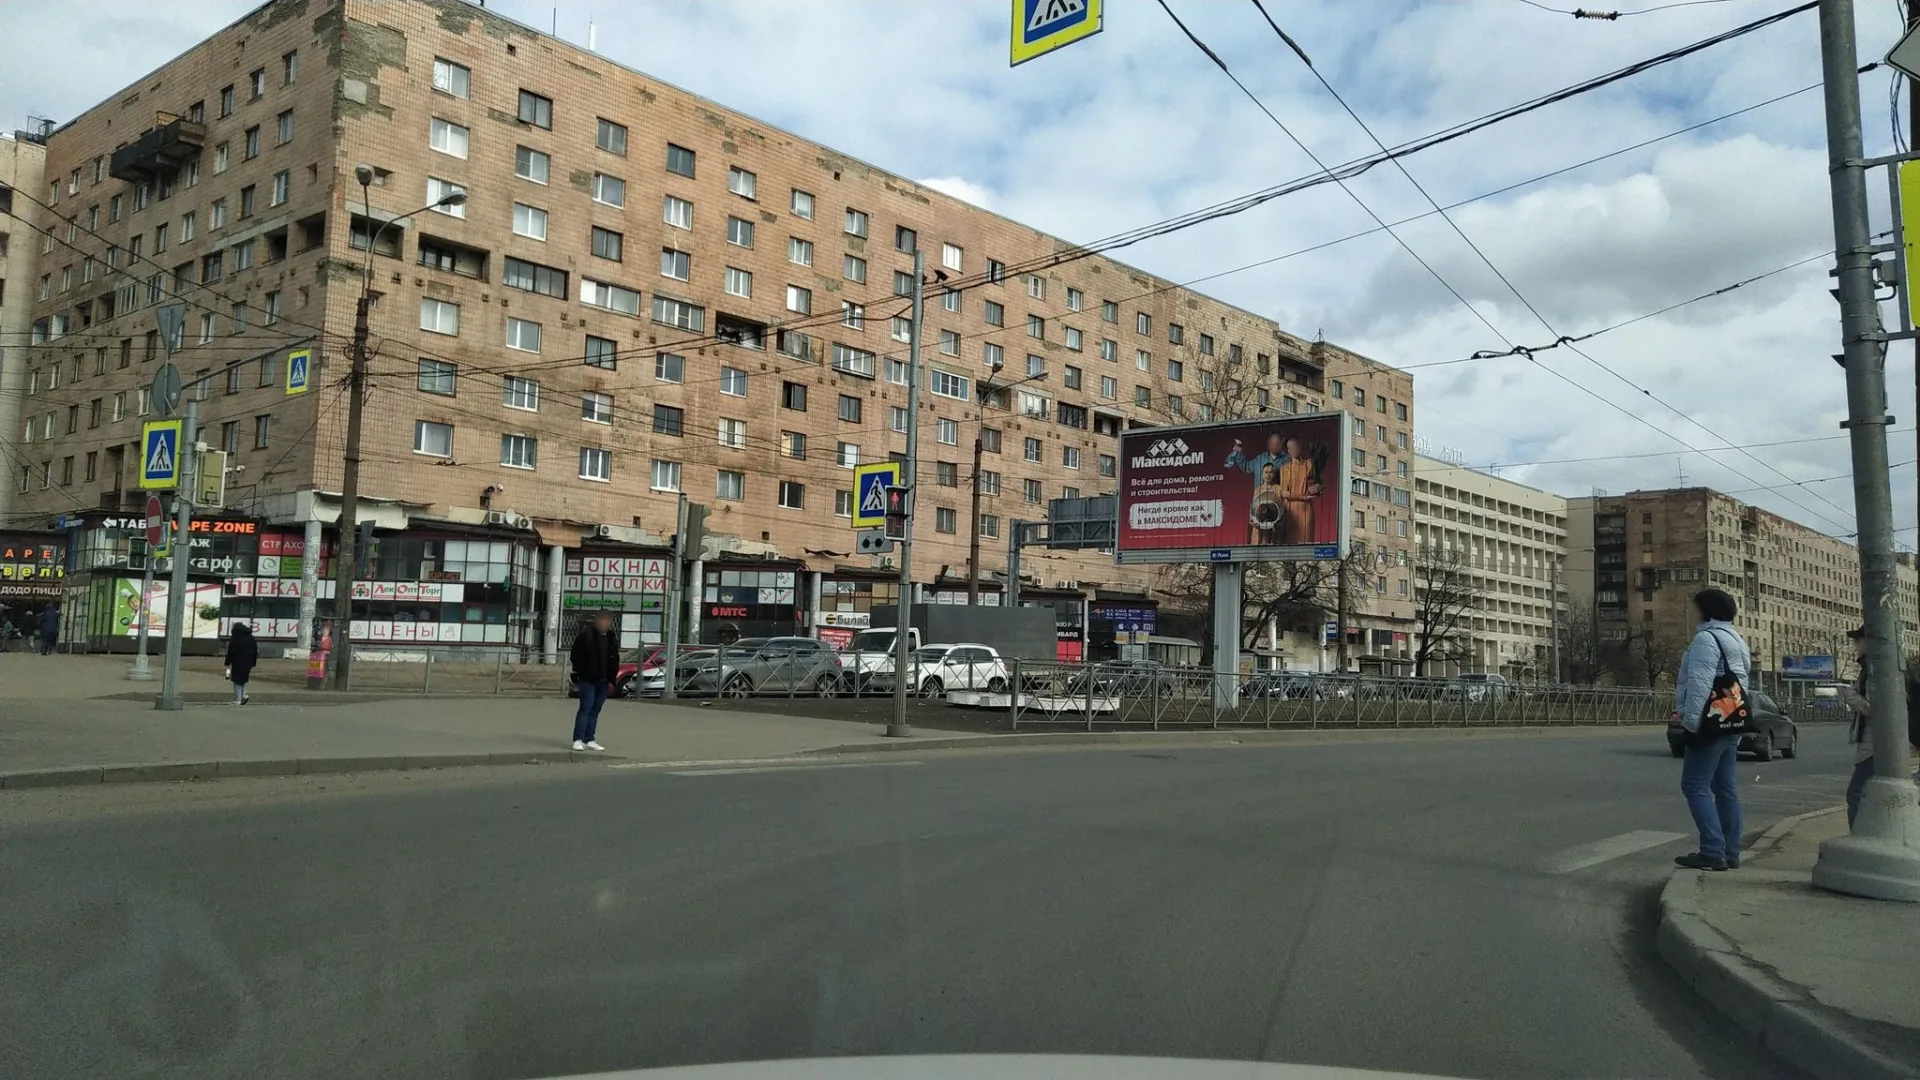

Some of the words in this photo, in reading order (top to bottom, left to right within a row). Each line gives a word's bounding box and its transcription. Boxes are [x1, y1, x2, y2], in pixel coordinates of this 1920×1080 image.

[1131, 477, 1146, 486] Всё
[1147, 478, 1162, 486] для
[1163, 477, 1187, 485] дома,
[1189, 474, 1224, 484] ремонта
[1137, 486, 1198, 497] строительства!
[1138, 506, 1162, 514] Нигде
[1163, 505, 1189, 513] кроме
[118, 518, 146, 529] ТАБ
[1143, 515, 1198, 525] МАКСИДОМЕ
[171, 520, 210, 532] VPE
[213, 522, 255, 533] ZONE
[587, 559, 660, 574] ОКНА
[229, 579, 300, 596] ПТЕКА
[568, 577, 665, 590] ПОТОЛКИ
[1, 586, 31, 595] ДОДО
[719, 607, 748, 617] МТС
[837, 614, 870, 626] Билай
[373, 625, 434, 637] ЦЕНЫ
